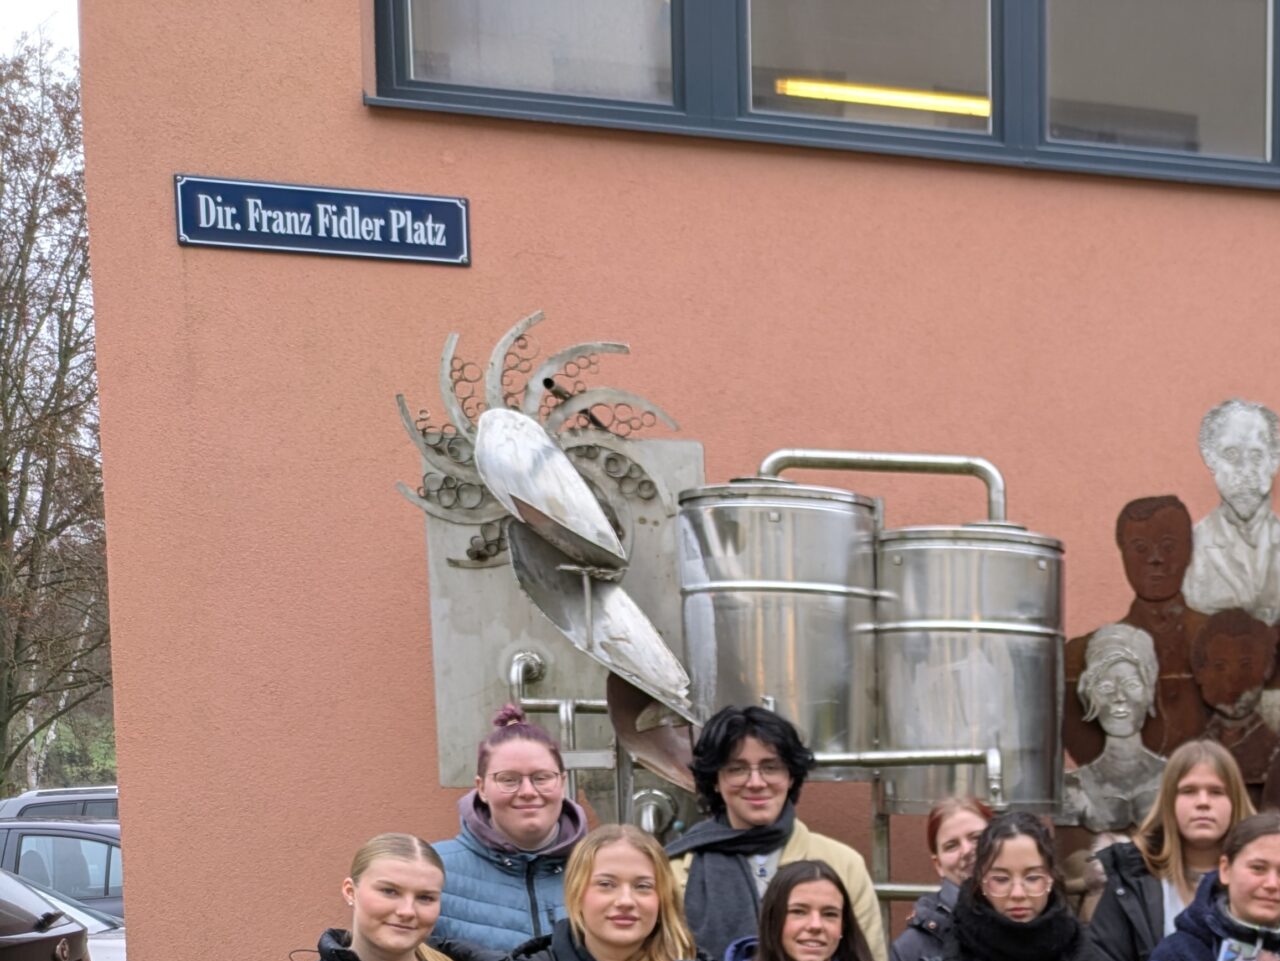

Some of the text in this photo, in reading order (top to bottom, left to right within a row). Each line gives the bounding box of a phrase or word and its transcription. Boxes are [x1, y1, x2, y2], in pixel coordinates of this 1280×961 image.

[198, 194, 446, 246] Dir. Franz Fidler Platz
